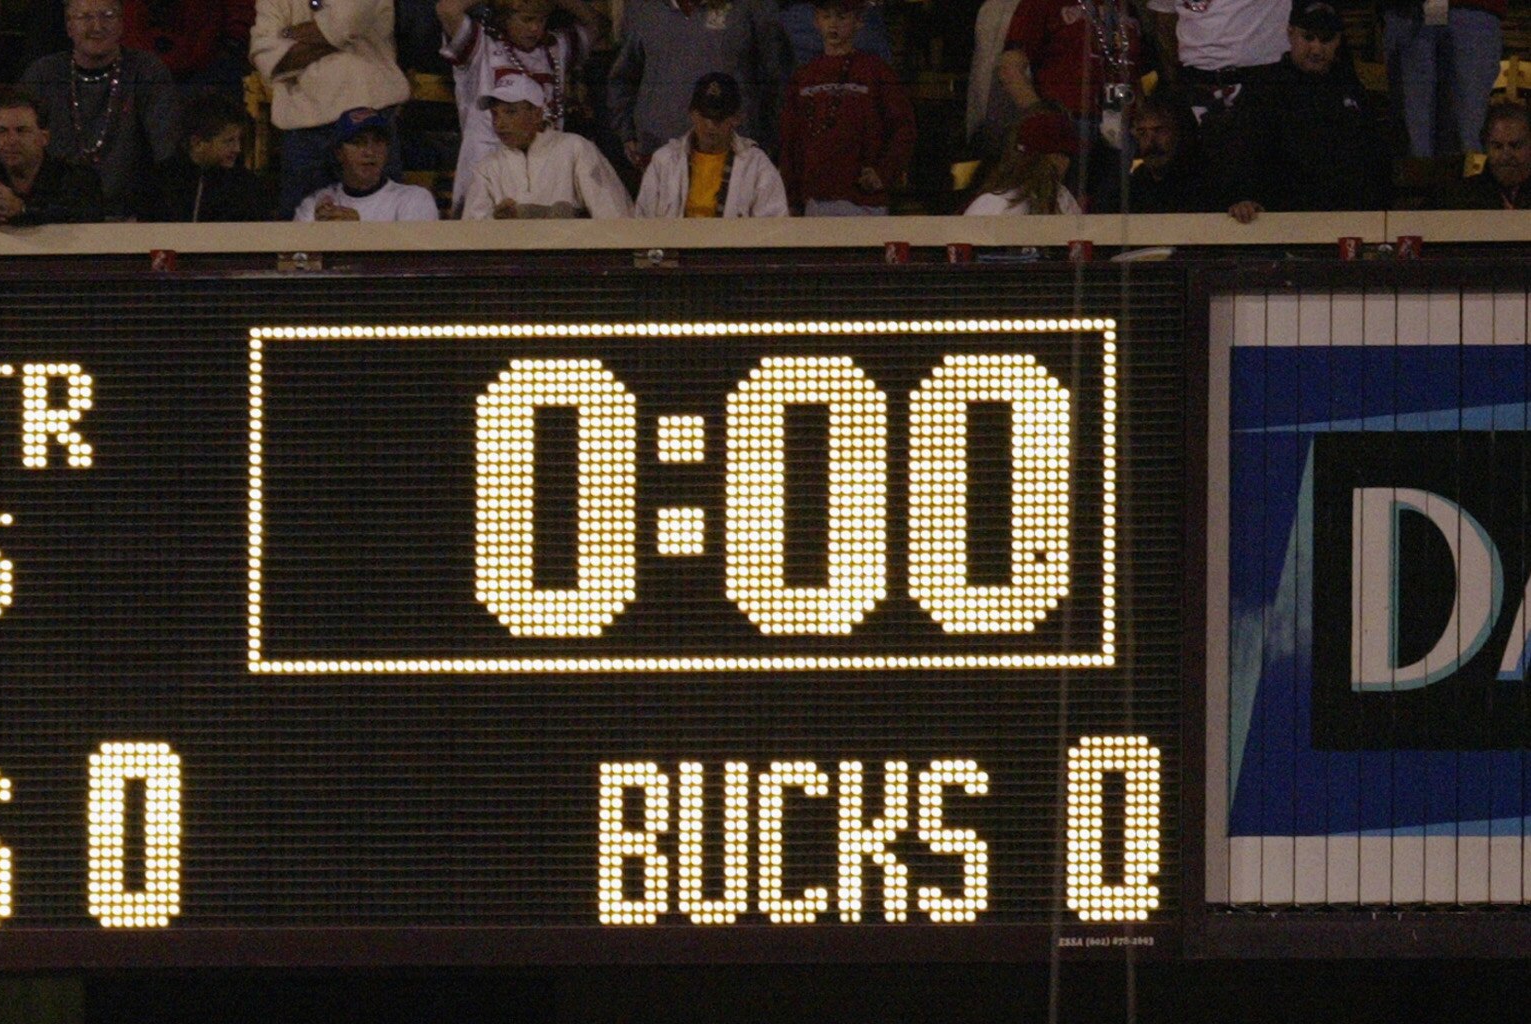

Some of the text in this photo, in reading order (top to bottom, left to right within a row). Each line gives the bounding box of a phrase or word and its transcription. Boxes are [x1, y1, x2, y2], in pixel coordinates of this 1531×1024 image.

[475, 354, 1071, 637] 0:00
[1351, 487, 1531, 692] D
[88, 742, 181, 928] 0
[598, 759, 989, 924] BUCKS
[1066, 735, 1161, 921] 0
